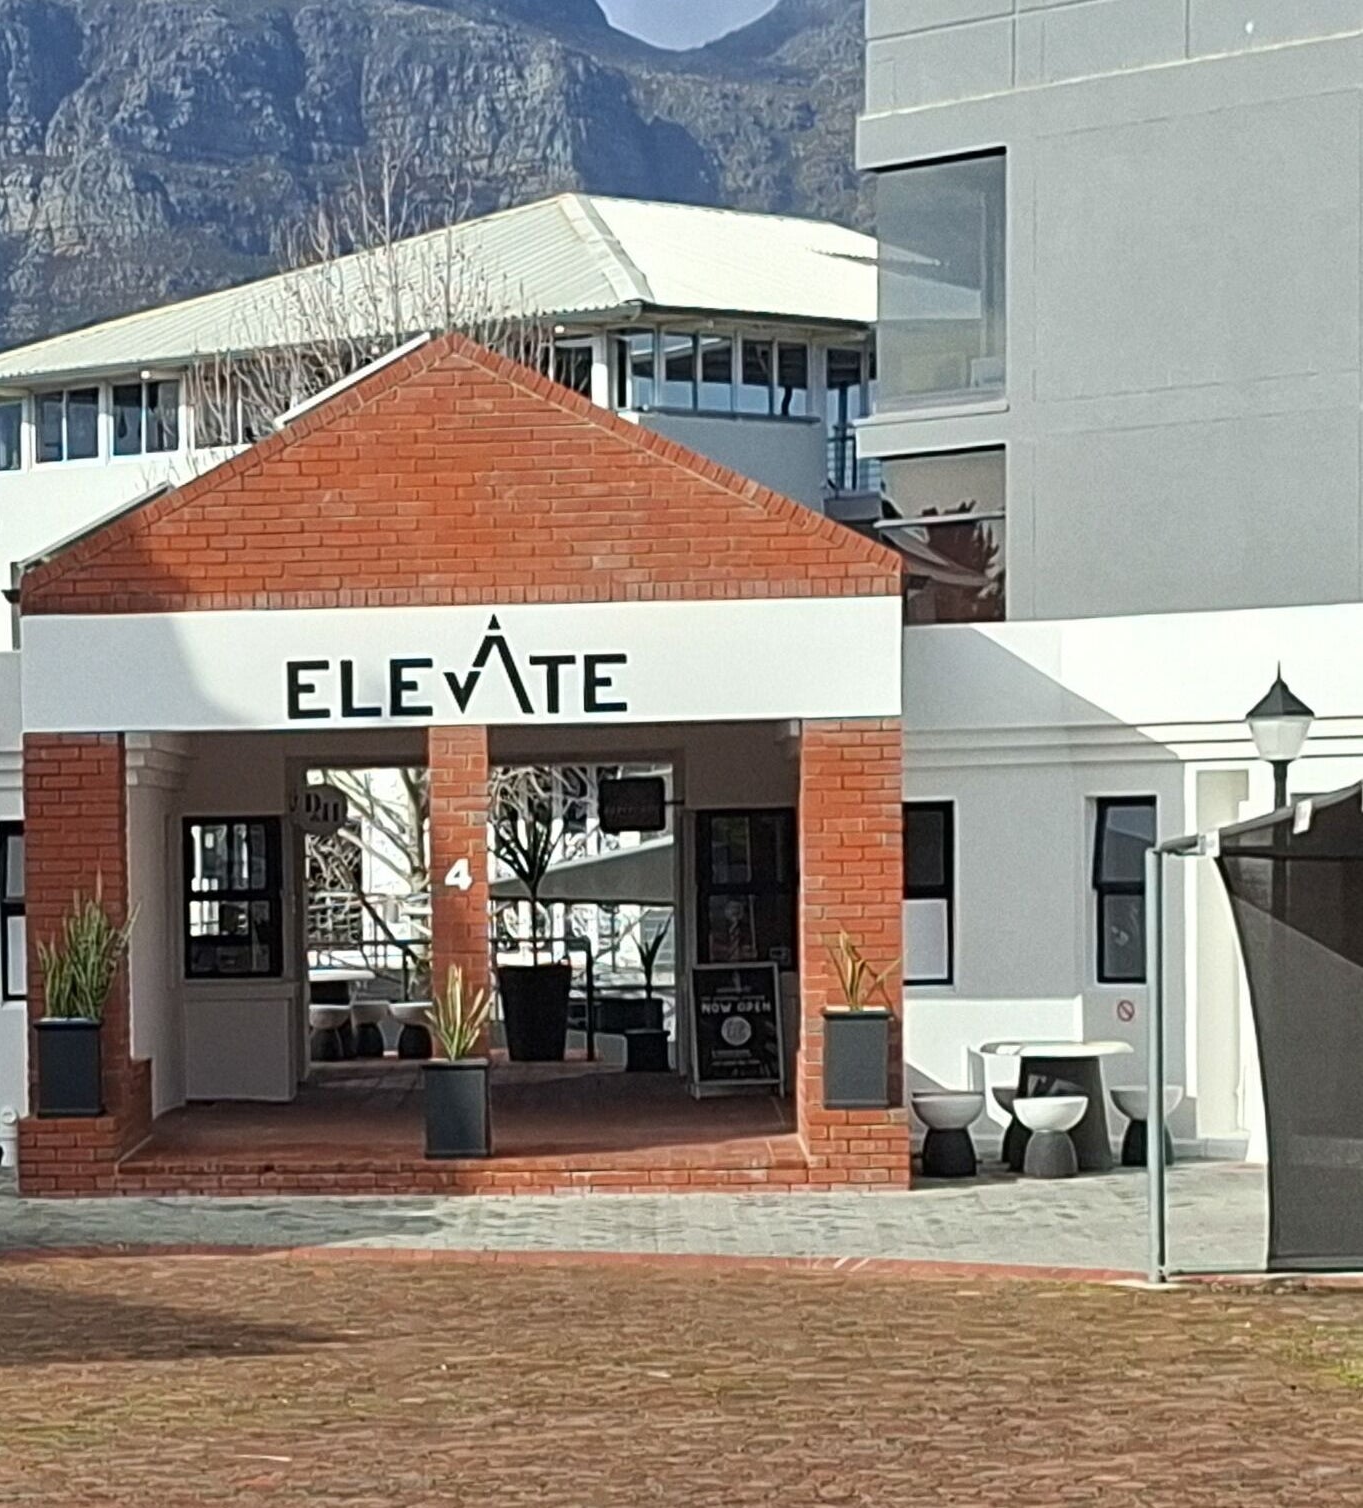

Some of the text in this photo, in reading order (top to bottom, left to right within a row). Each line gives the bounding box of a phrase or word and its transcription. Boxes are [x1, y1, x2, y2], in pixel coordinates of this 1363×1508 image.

[287, 613, 628, 719] ELEVATE
[444, 858, 473, 891] 4
[701, 1001, 771, 1014] NOW OPEN
